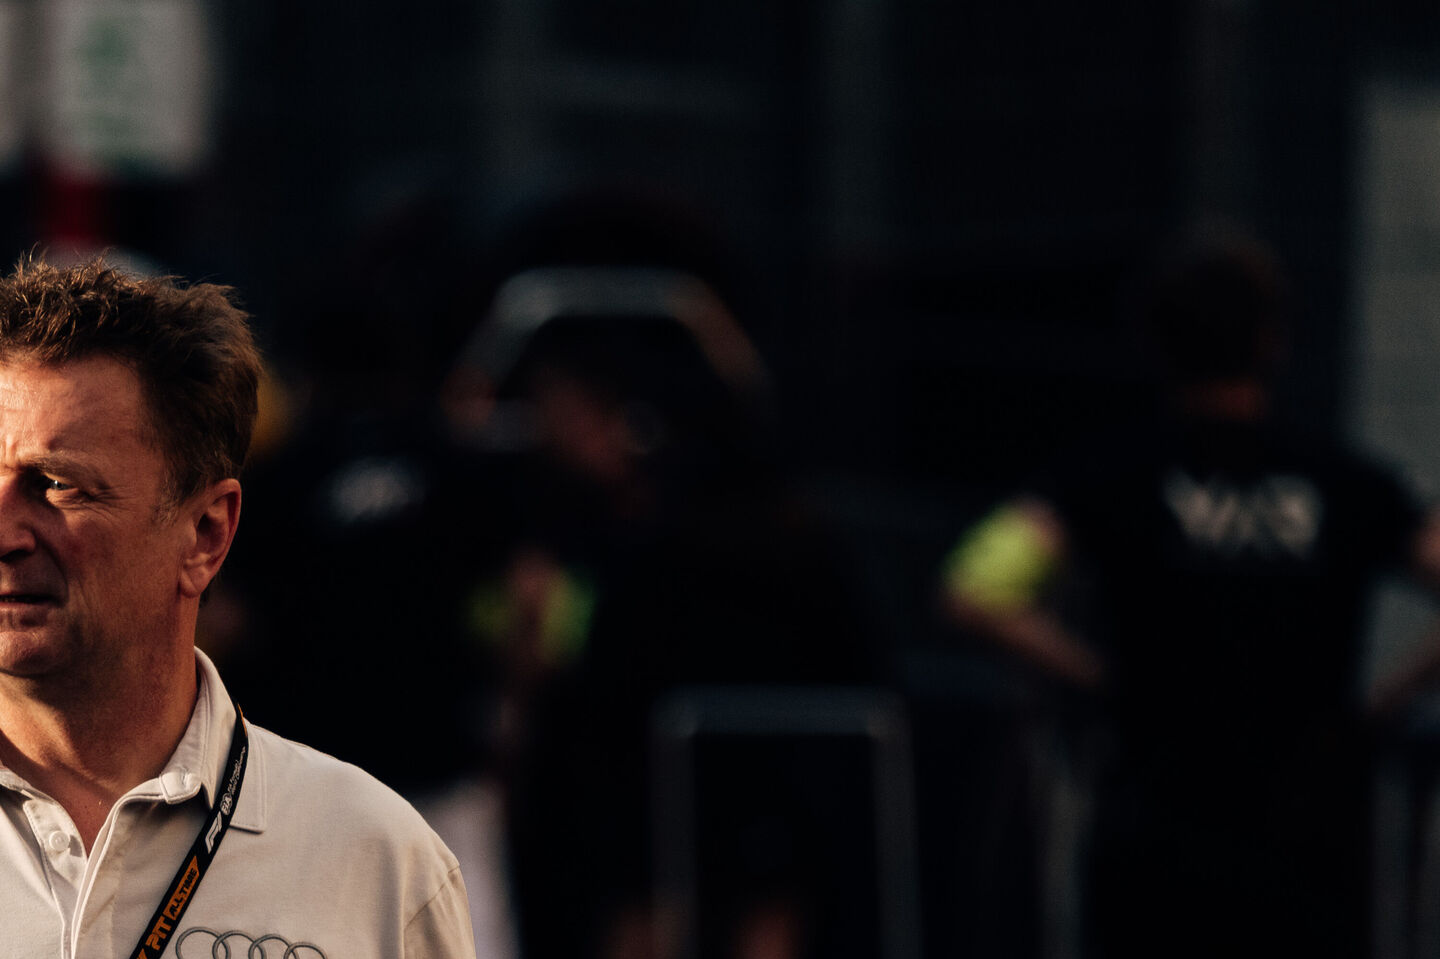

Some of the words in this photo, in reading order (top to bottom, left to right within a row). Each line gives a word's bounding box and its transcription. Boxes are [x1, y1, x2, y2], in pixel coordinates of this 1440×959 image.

[145, 915, 172, 951] PIT
[169, 895, 184, 918] ALL
[179, 867, 198, 897] TIME
